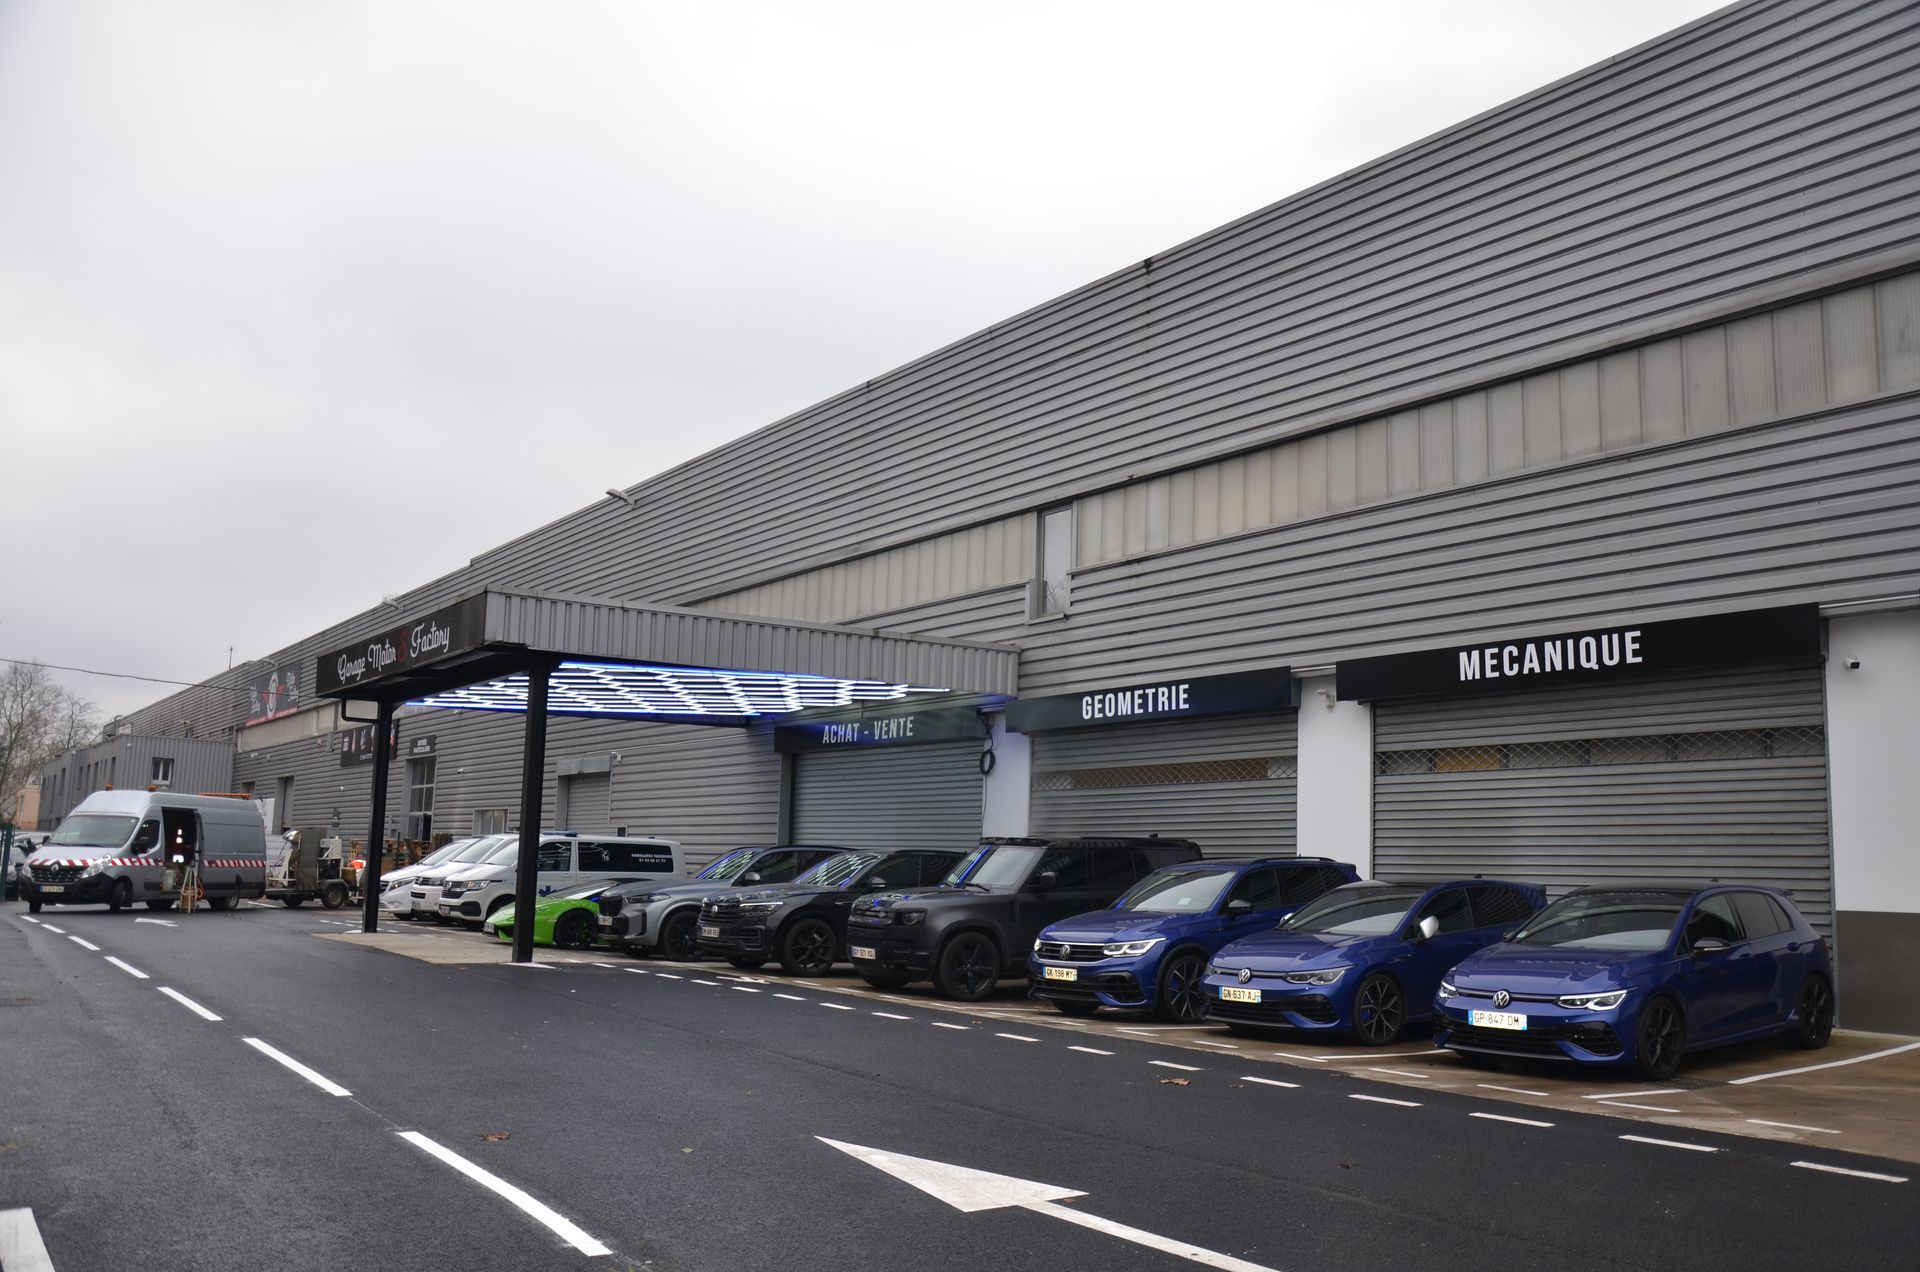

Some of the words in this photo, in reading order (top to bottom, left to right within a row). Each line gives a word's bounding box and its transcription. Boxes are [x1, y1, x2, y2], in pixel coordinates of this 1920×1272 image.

[337, 654, 366, 684] Garage
[410, 621, 450, 658] Factory
[1459, 630, 1643, 681] MECANIQUE
[1082, 683, 1190, 720] GEOMETRIE
[822, 722, 860, 744] ACHAT
[873, 716, 914, 740] VENTE
